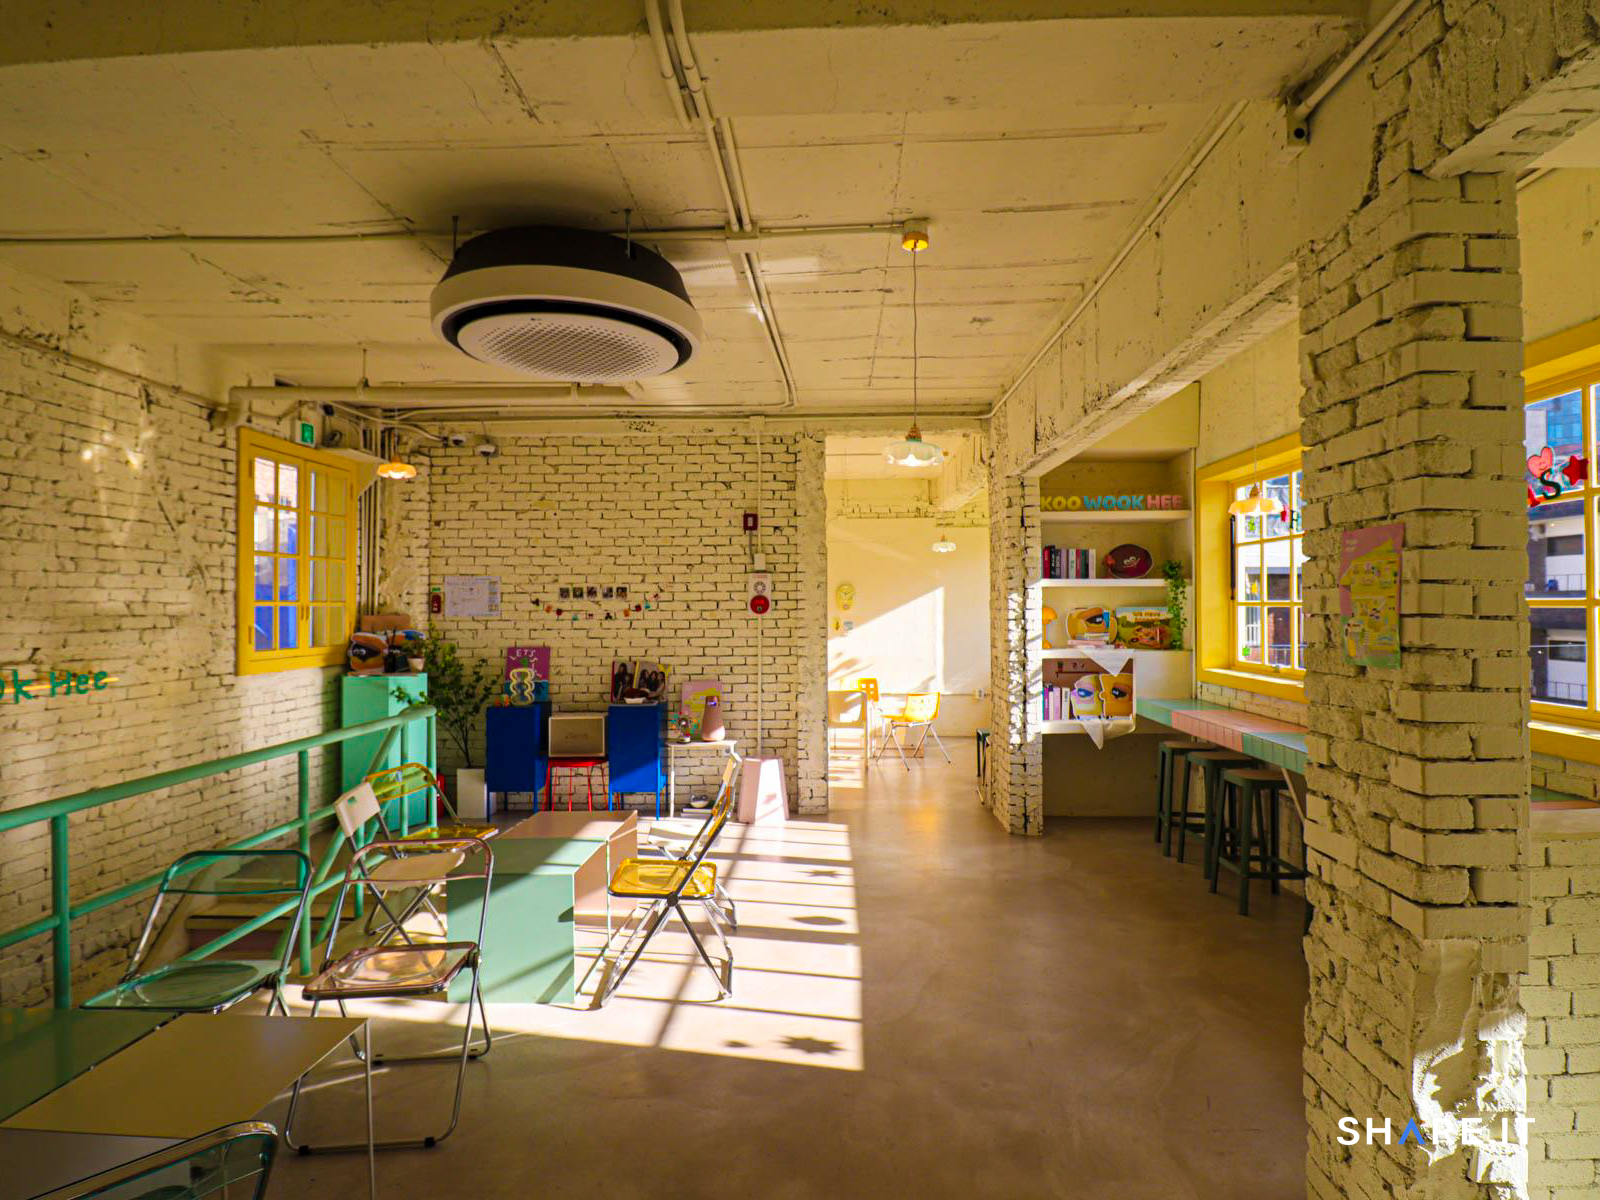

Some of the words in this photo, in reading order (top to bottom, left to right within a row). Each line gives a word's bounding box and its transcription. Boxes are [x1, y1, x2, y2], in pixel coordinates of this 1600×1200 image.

[1040, 495, 1082, 511] KOO
[1083, 495, 1145, 511] WOOK
[1147, 494, 1183, 510] HEE
